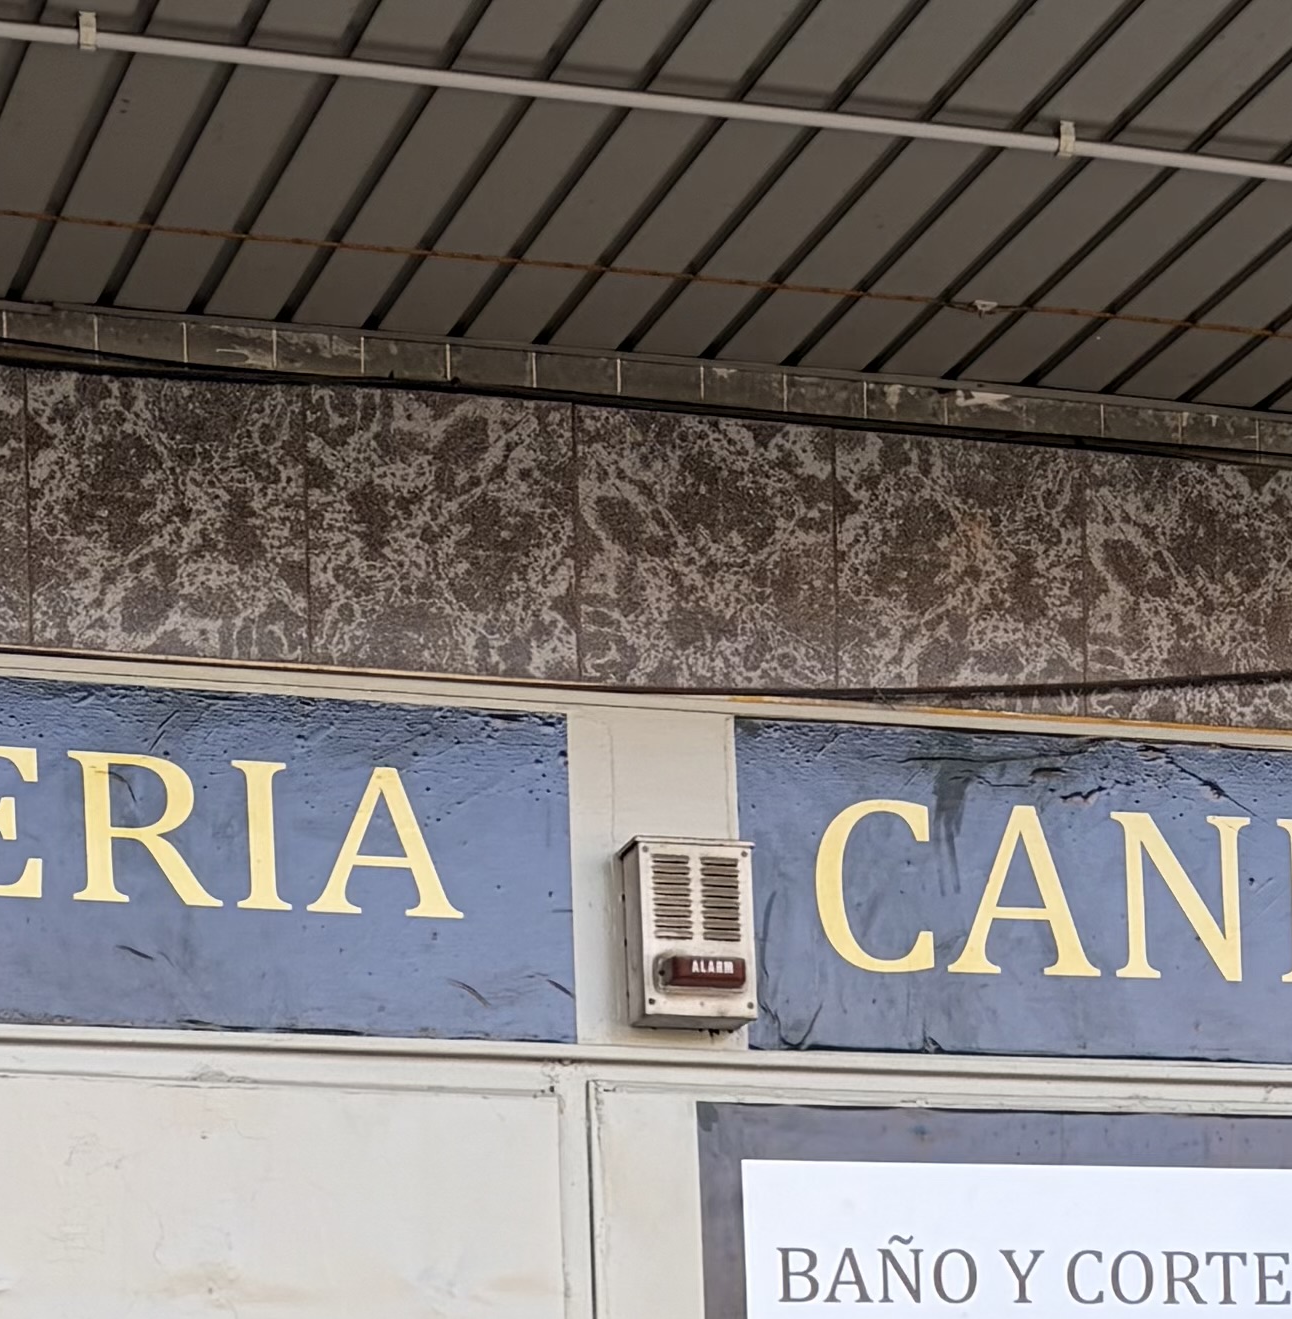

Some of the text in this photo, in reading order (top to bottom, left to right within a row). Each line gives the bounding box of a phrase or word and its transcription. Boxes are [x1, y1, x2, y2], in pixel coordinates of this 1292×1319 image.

[691, 959, 735, 974] ALARM
[776, 1234, 1292, 1305] BAÑO Y CORTE
